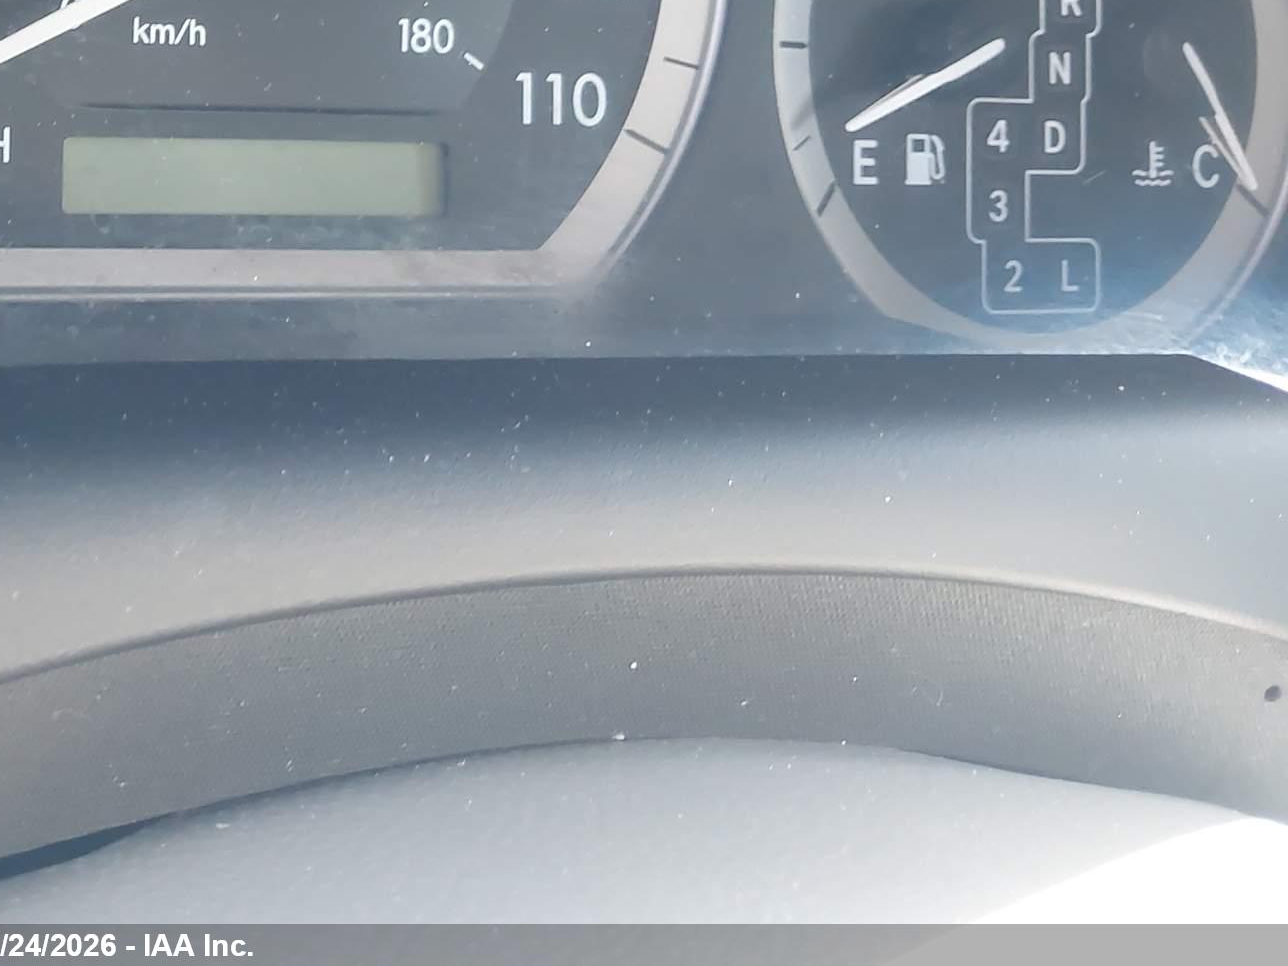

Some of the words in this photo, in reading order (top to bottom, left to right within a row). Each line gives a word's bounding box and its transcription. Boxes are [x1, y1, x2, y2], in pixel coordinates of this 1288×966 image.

[132, 16, 207, 46] km/h
[398, 17, 455, 54] 180
[1049, 51, 1071, 85] N
[515, 72, 607, 127] 110
[986, 119, 1010, 153] 4
[1044, 120, 1066, 154] D
[853, 139, 879, 185] E
[1192, 143, 1220, 189] C
[988, 189, 1008, 223] 3
[1003, 259, 1023, 293] 2
[1060, 259, 1080, 292] L
